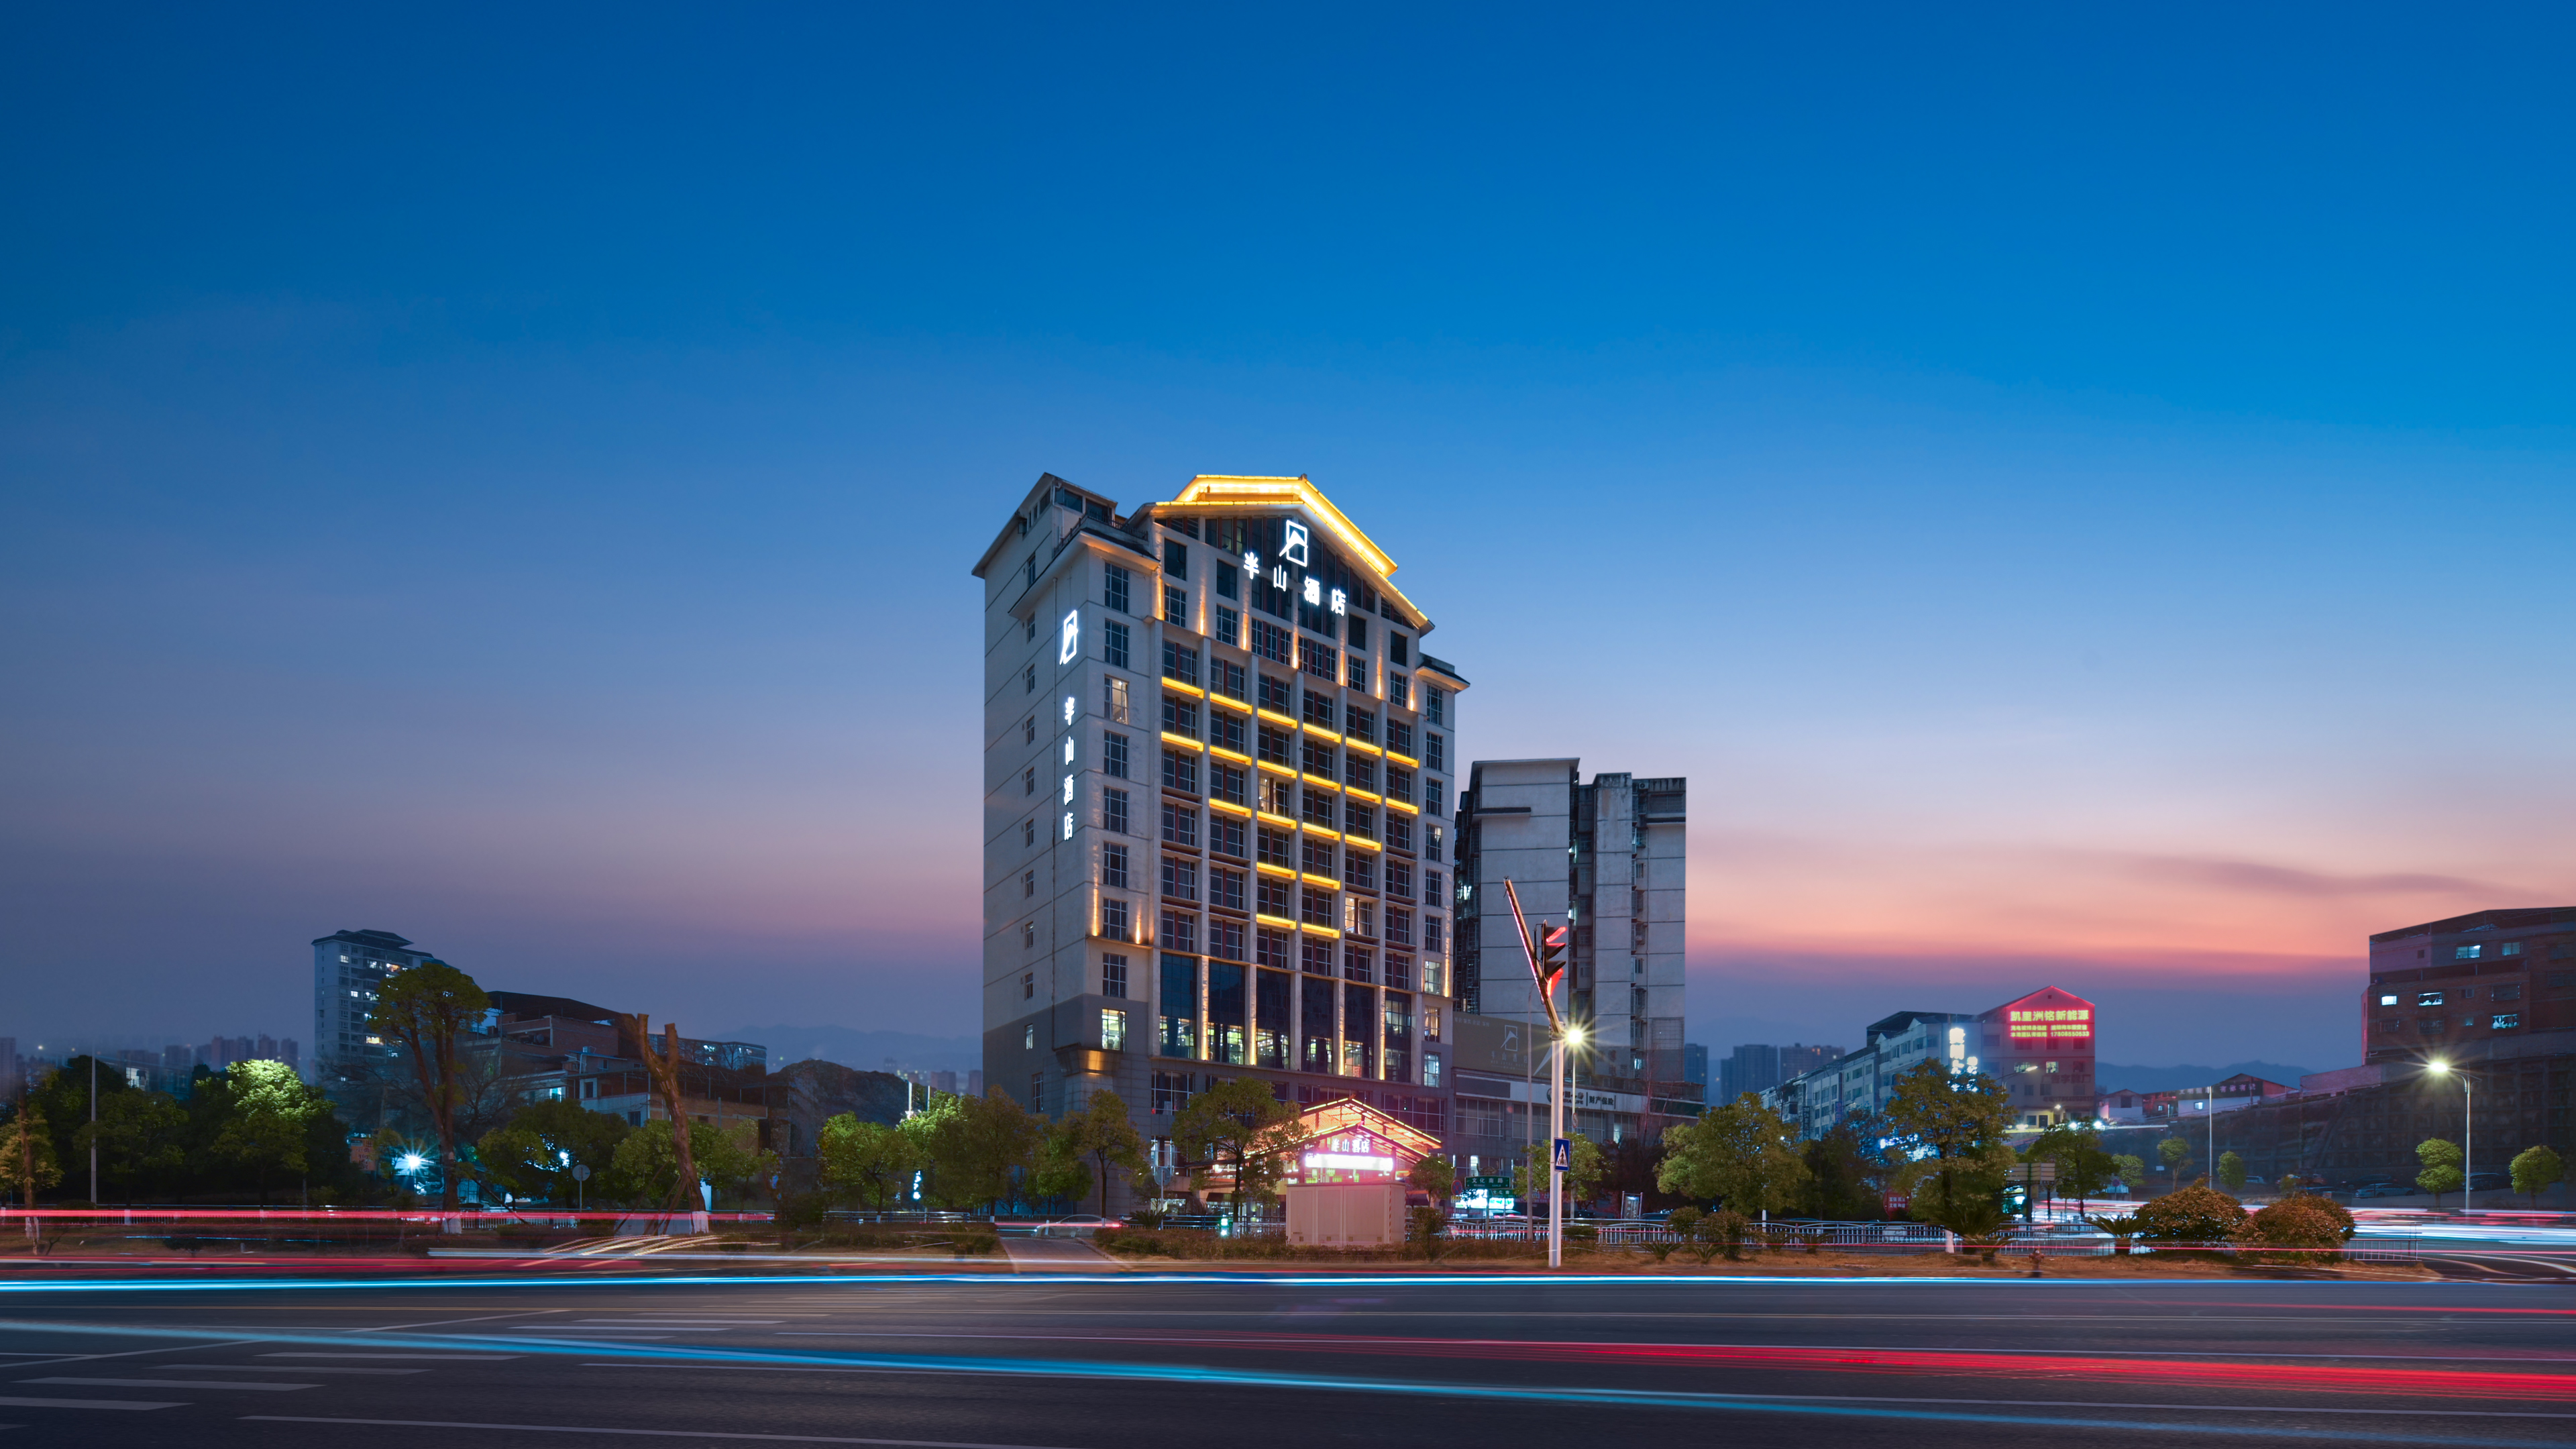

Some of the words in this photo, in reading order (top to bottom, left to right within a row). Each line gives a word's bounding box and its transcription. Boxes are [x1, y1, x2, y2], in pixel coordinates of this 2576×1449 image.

[1244, 551, 1346, 616] 半山酒店
[1064, 696, 1075, 841] 半山酒店
[1491, 1051, 1527, 1063] 半山酒店
[1589, 1095, 1614, 1106] 财产保险
